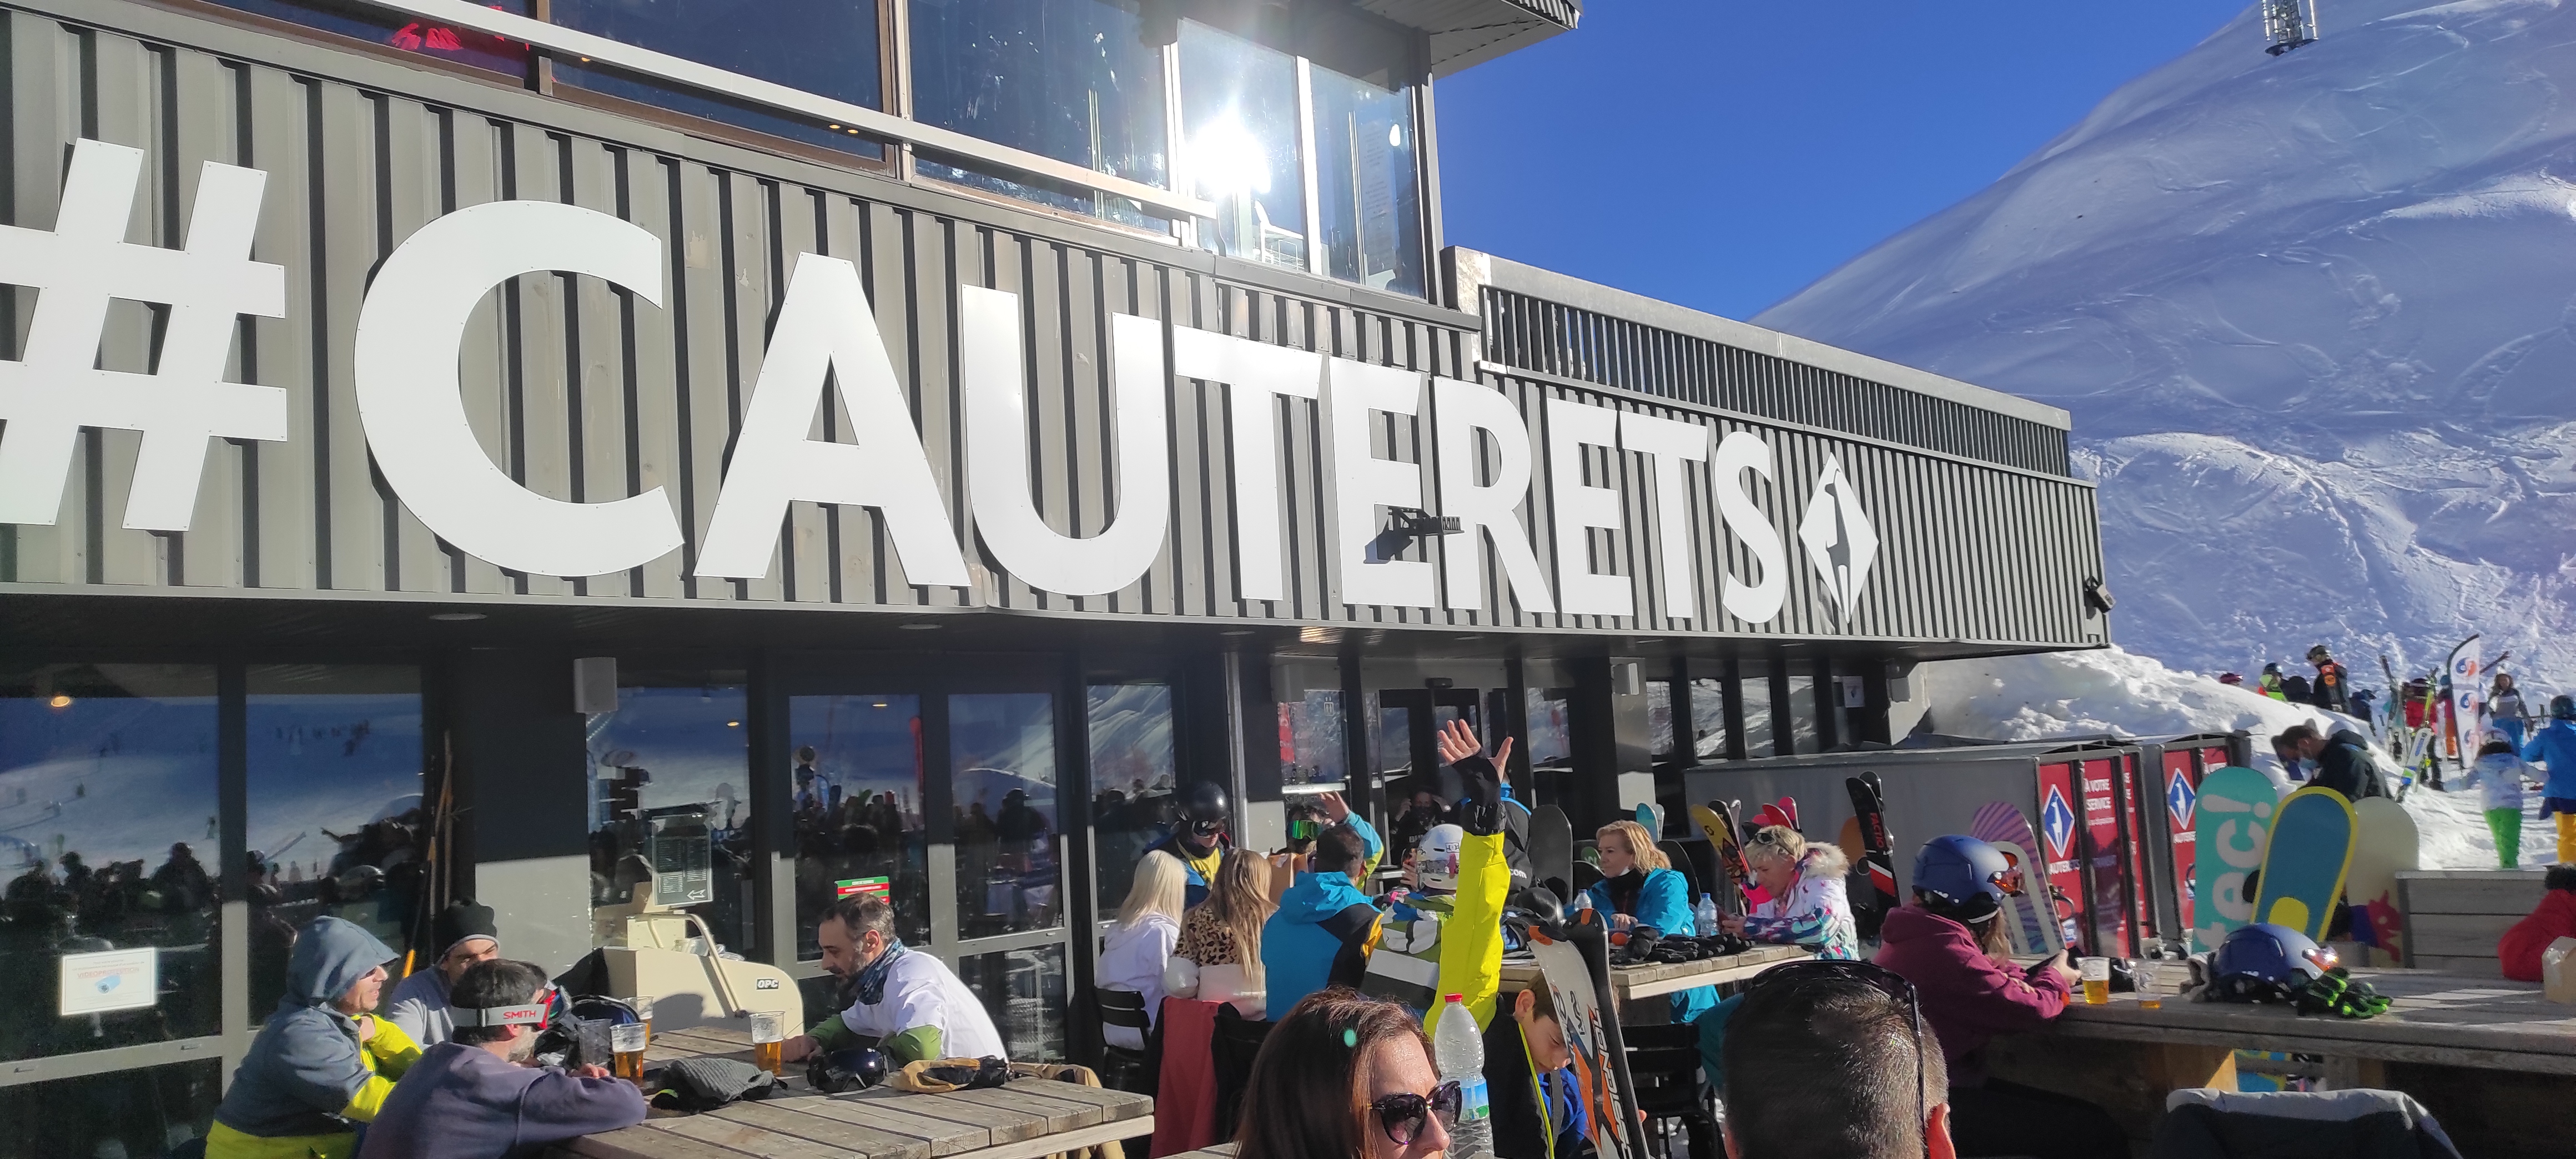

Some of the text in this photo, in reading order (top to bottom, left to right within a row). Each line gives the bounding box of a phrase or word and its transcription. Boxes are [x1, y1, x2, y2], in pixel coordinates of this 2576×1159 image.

[0, 138, 1787, 624] #CAUTERETS
[757, 980, 778, 988] OPC
[503, 1010, 536, 1020] SMITH
